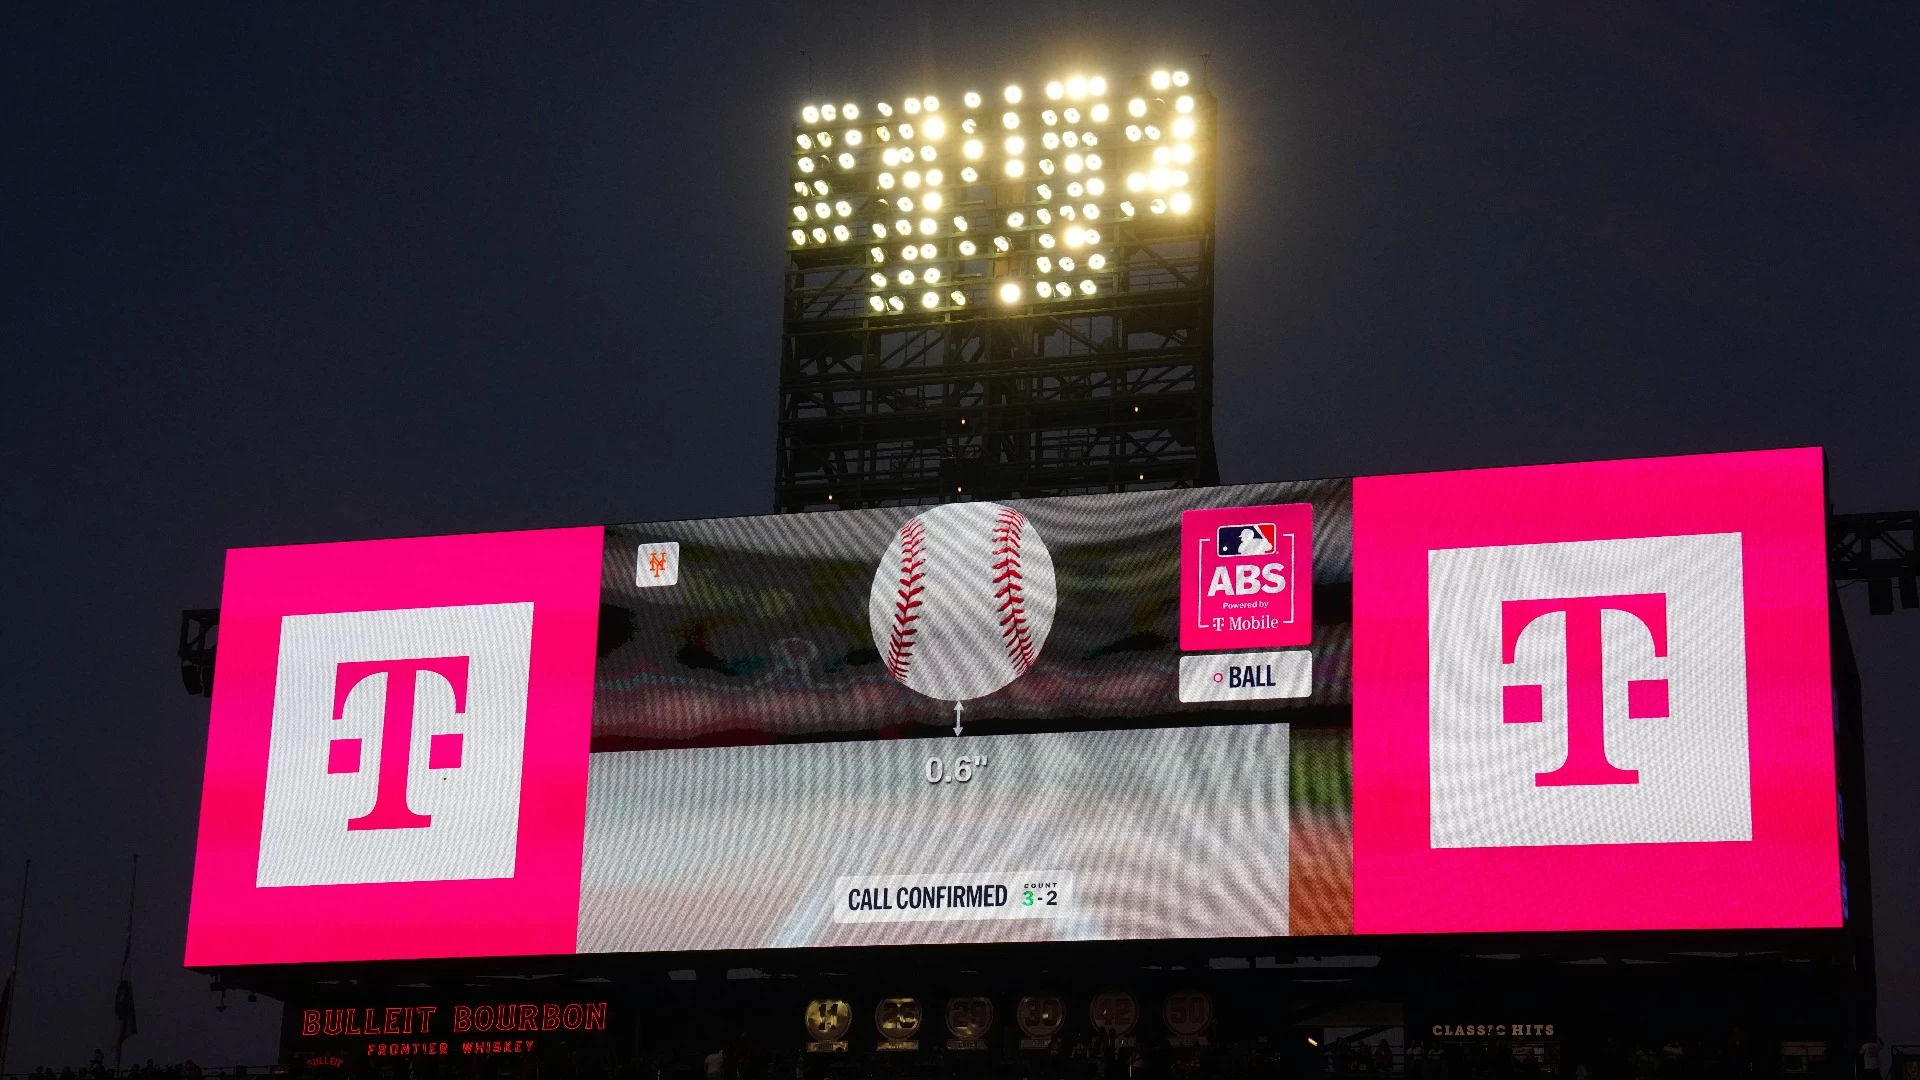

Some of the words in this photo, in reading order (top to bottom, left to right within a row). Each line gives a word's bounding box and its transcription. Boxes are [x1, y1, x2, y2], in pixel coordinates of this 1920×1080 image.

[1207, 562, 1287, 597] ABS
[1222, 600, 1257, 610] Powered
[1259, 600, 1269, 609] by
[1229, 615, 1279, 631] Mobile
[1229, 664, 1276, 689] BALL
[1501, 593, 1669, 787] T
[328, 655, 470, 831] T
[925, 755, 989, 783] 0.6"
[848, 887, 892, 911] CALL
[896, 884, 1008, 910] CONFIRMED
[302, 1006, 438, 1036] BULLEIT
[453, 1002, 607, 1033] BOURBON
[817, 1003, 839, 1031] 11
[882, 1002, 917, 1029] 26
[953, 1000, 986, 1028] 29
[1024, 999, 1058, 1027] 30
[1096, 998, 1131, 1025] 42
[1170, 996, 1205, 1024] 50
[1511, 1024, 1555, 1036] HITS
[367, 1042, 448, 1056] FRONTIER
[462, 1040, 534, 1054] WHISKEY
